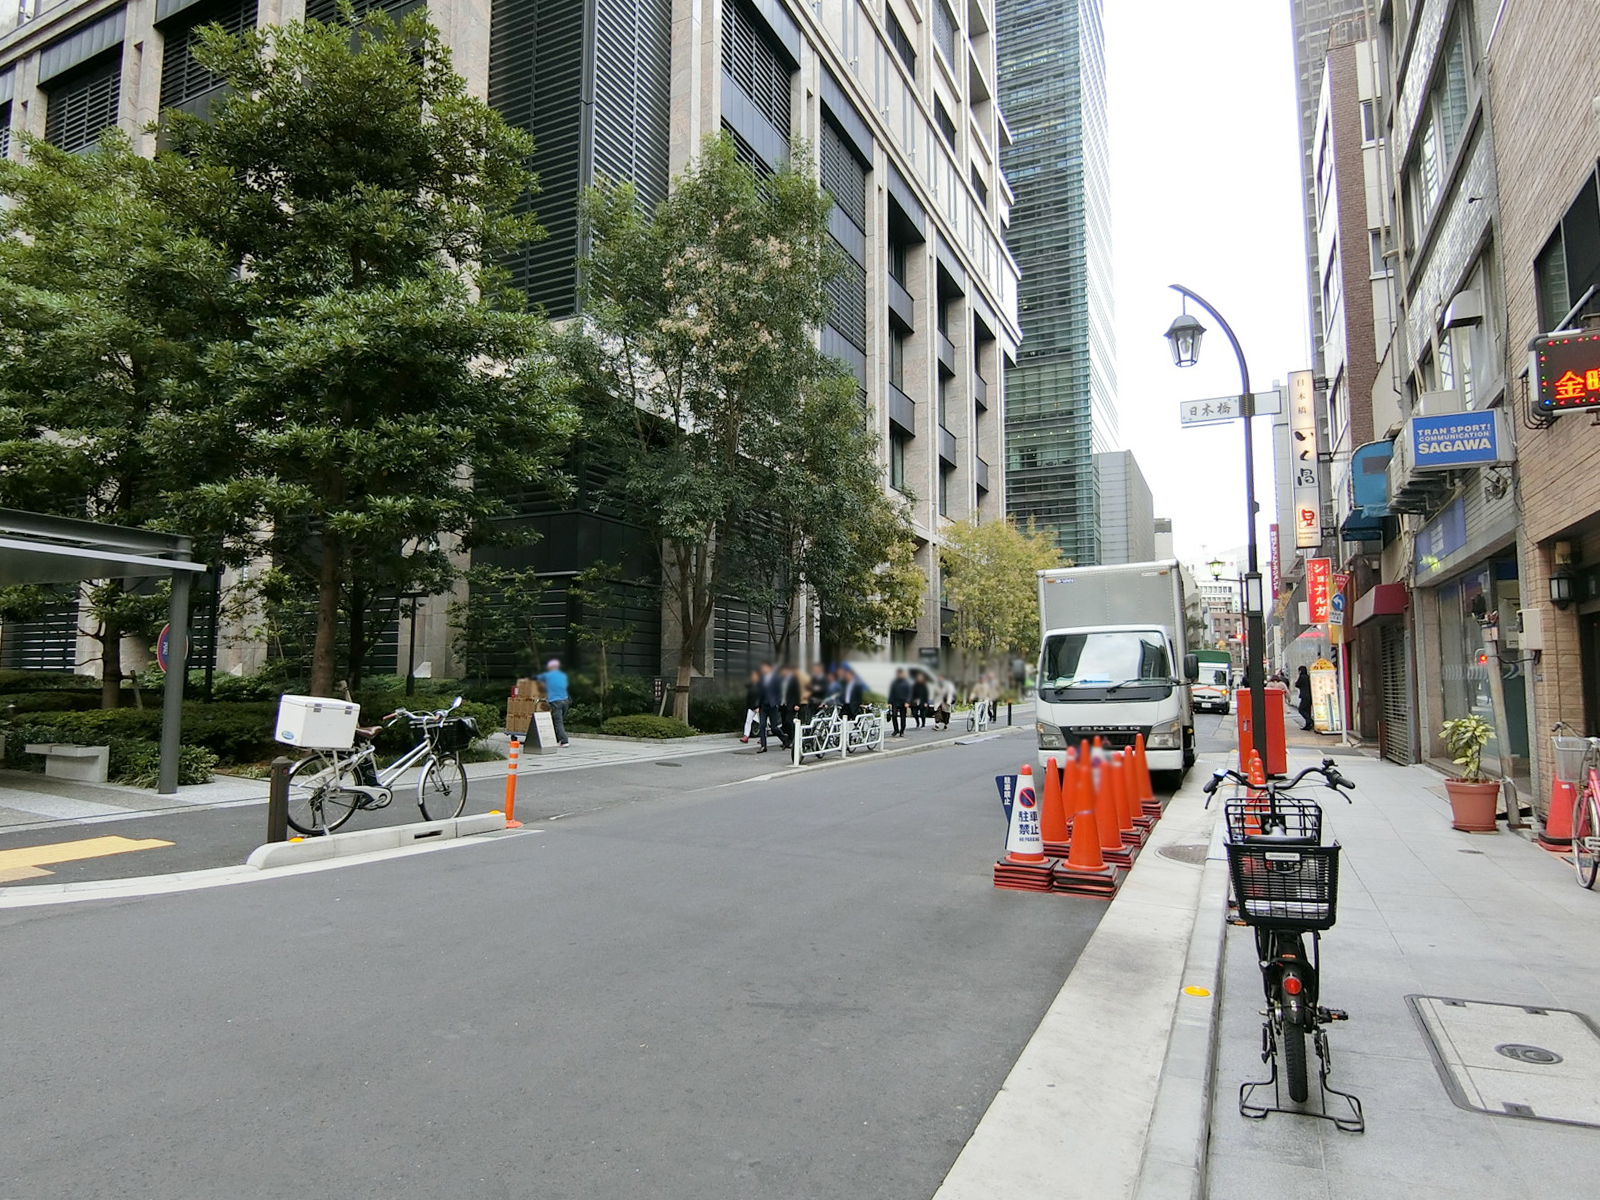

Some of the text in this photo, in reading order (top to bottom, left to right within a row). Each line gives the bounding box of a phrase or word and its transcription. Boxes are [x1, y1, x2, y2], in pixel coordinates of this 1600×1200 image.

[1189, 402, 1231, 417] 日本橋
[1418, 430, 1490, 442] COMMUNICATION
[1417, 437, 1492, 455] SAGAWA
[1018, 810, 1038, 822] 駐車
[1019, 823, 1039, 835] 禁止
